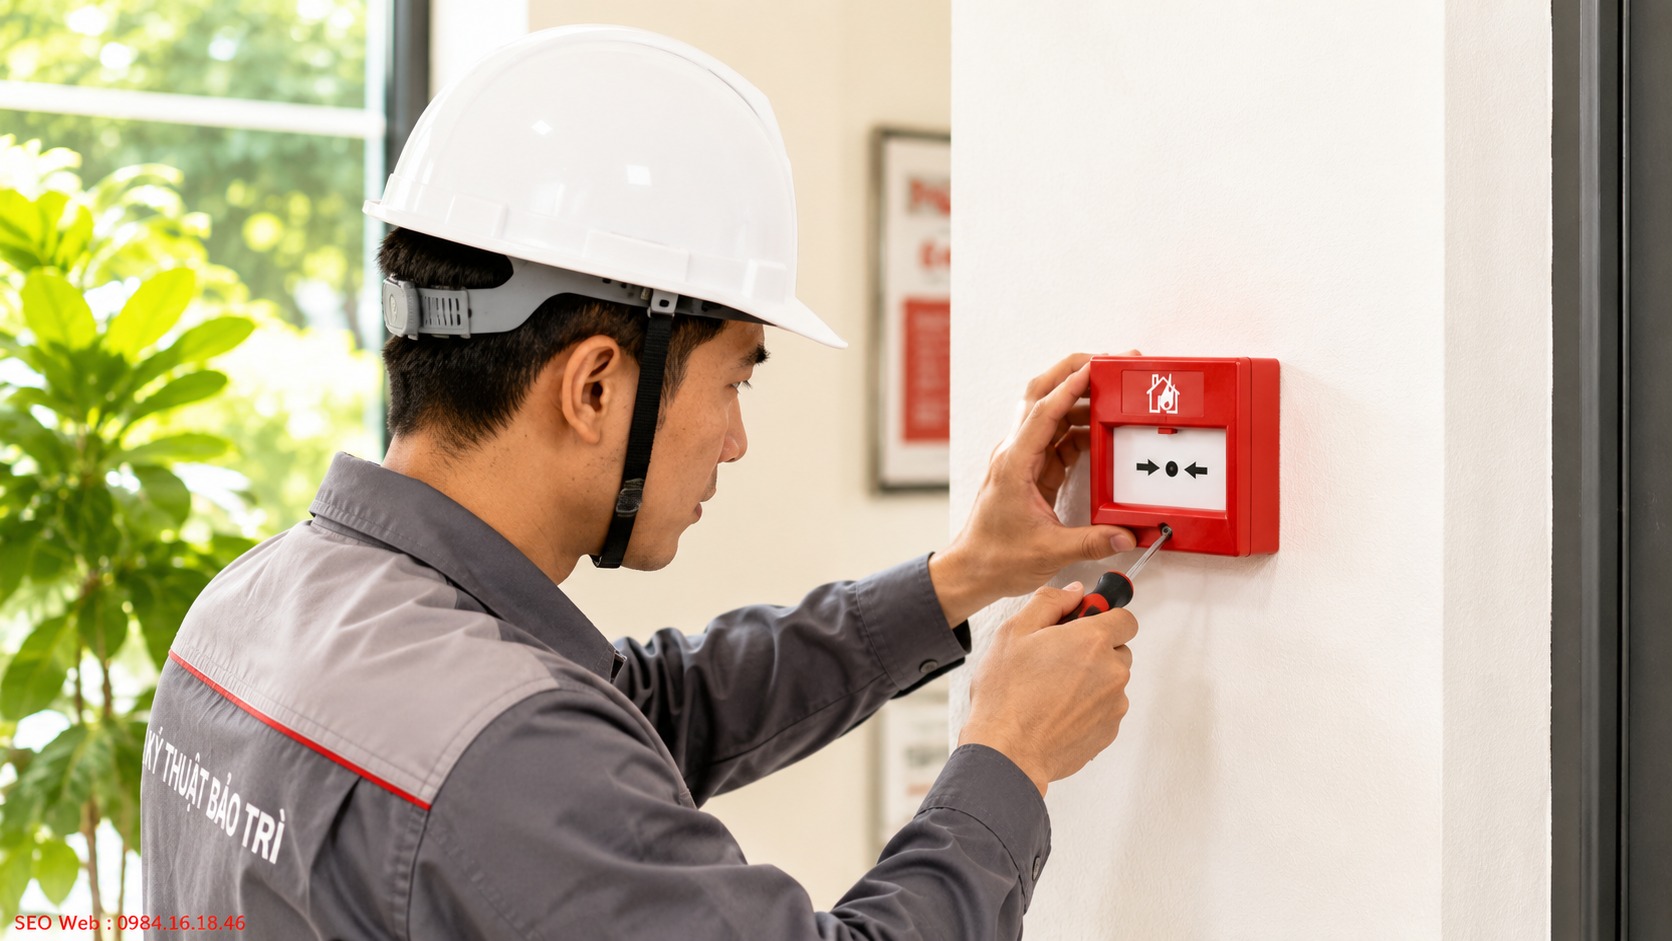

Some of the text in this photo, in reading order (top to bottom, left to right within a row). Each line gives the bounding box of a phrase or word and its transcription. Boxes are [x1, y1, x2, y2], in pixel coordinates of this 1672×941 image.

[162, 742, 210, 812] THUẬT
[205, 771, 241, 838] BẢO
[241, 802, 286, 865] TRÌ
